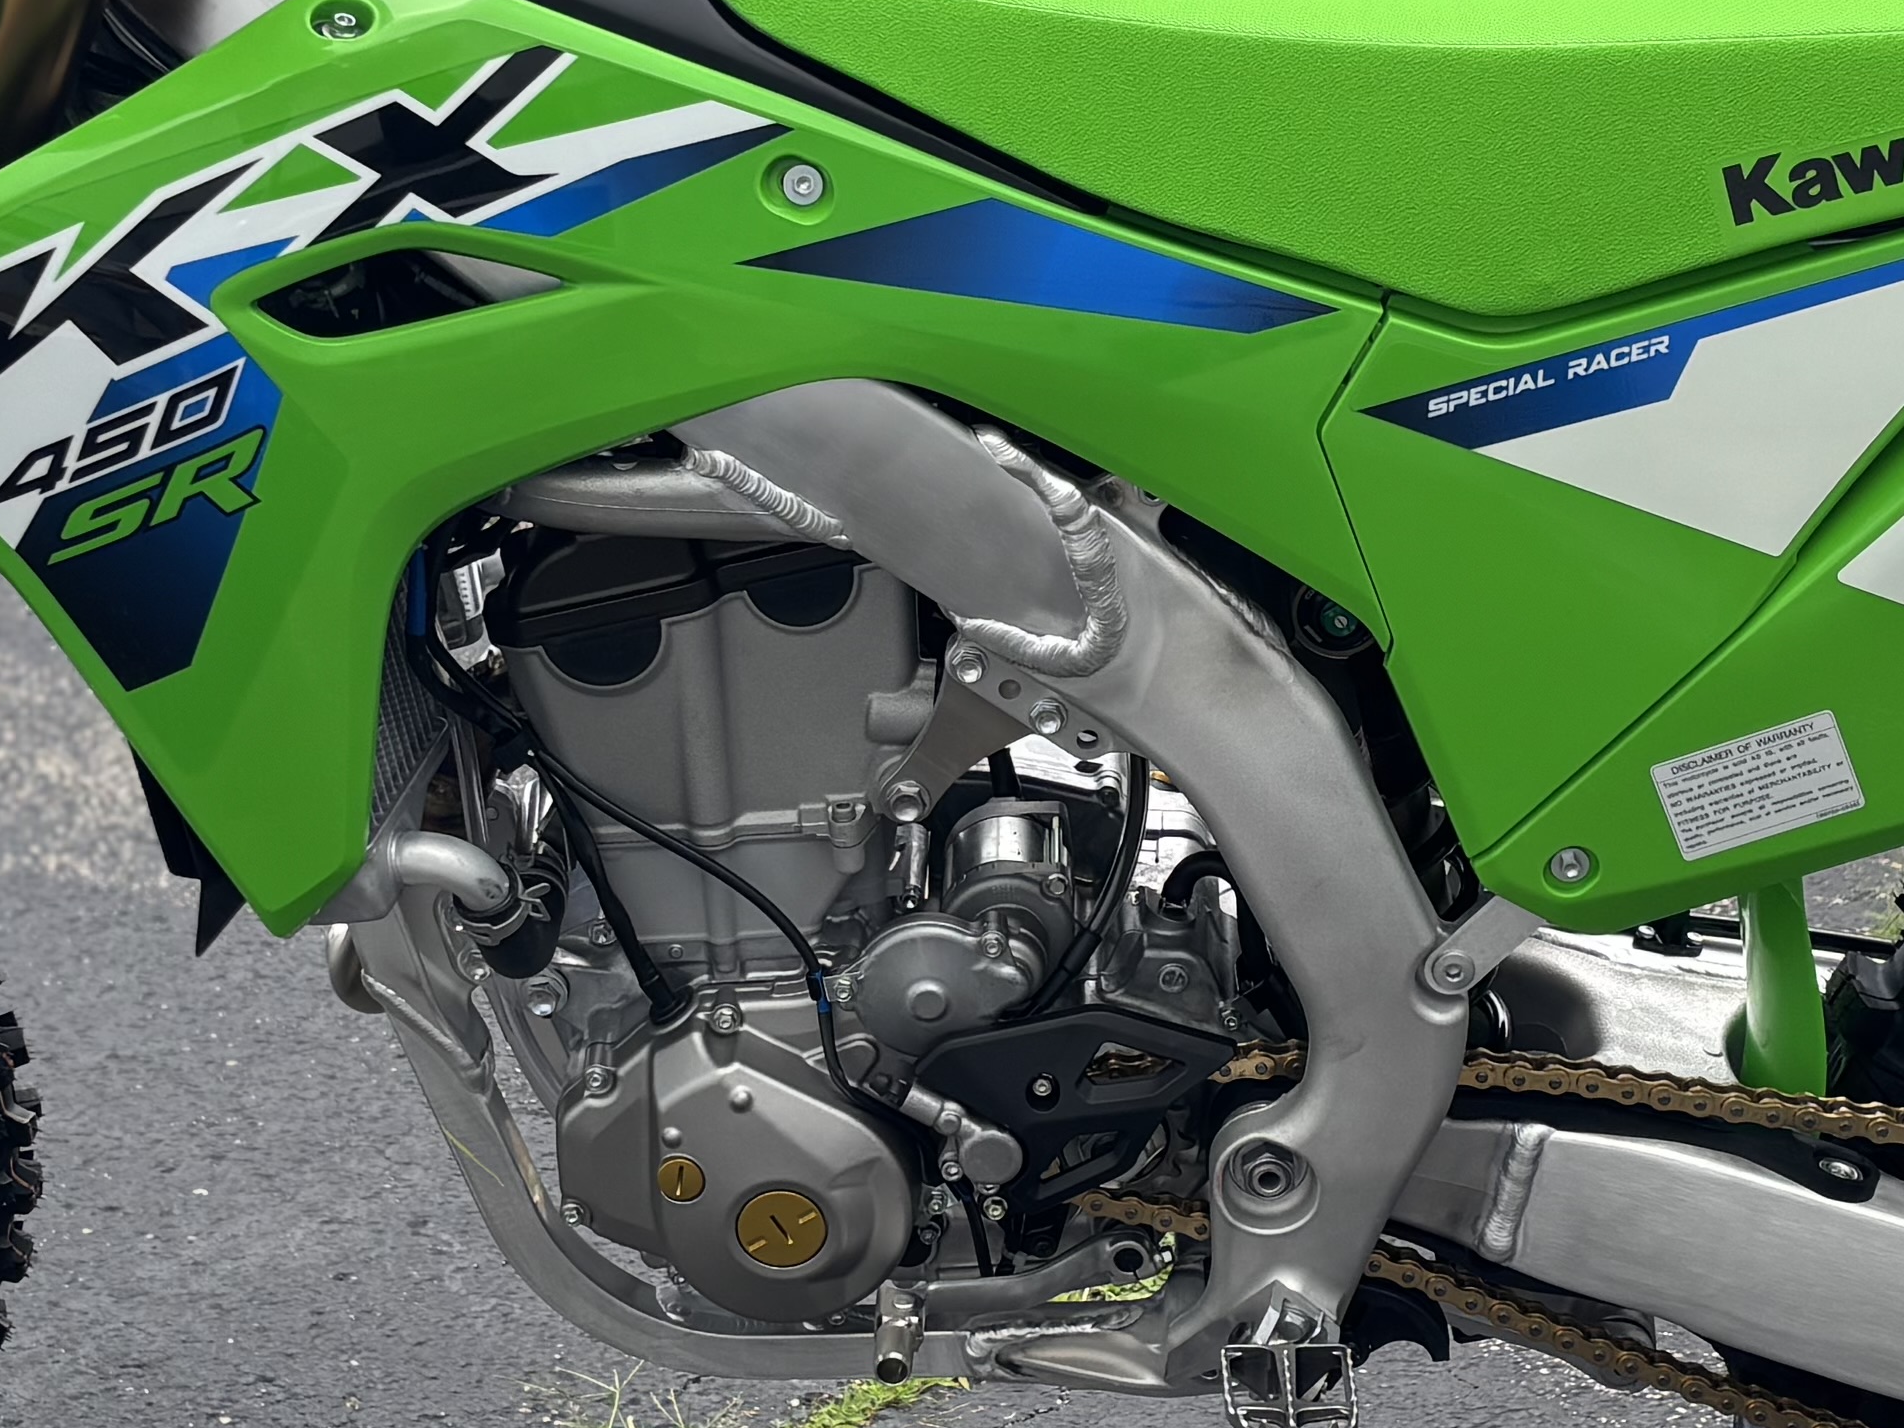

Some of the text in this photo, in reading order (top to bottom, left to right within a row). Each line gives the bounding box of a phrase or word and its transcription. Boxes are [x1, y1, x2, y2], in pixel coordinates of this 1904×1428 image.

[1426, 334, 1671, 419] SPECIAL RACER
[48, 424, 268, 566] SR
[1669, 721, 1816, 775] DISCLAIMER OF WARRANTY
